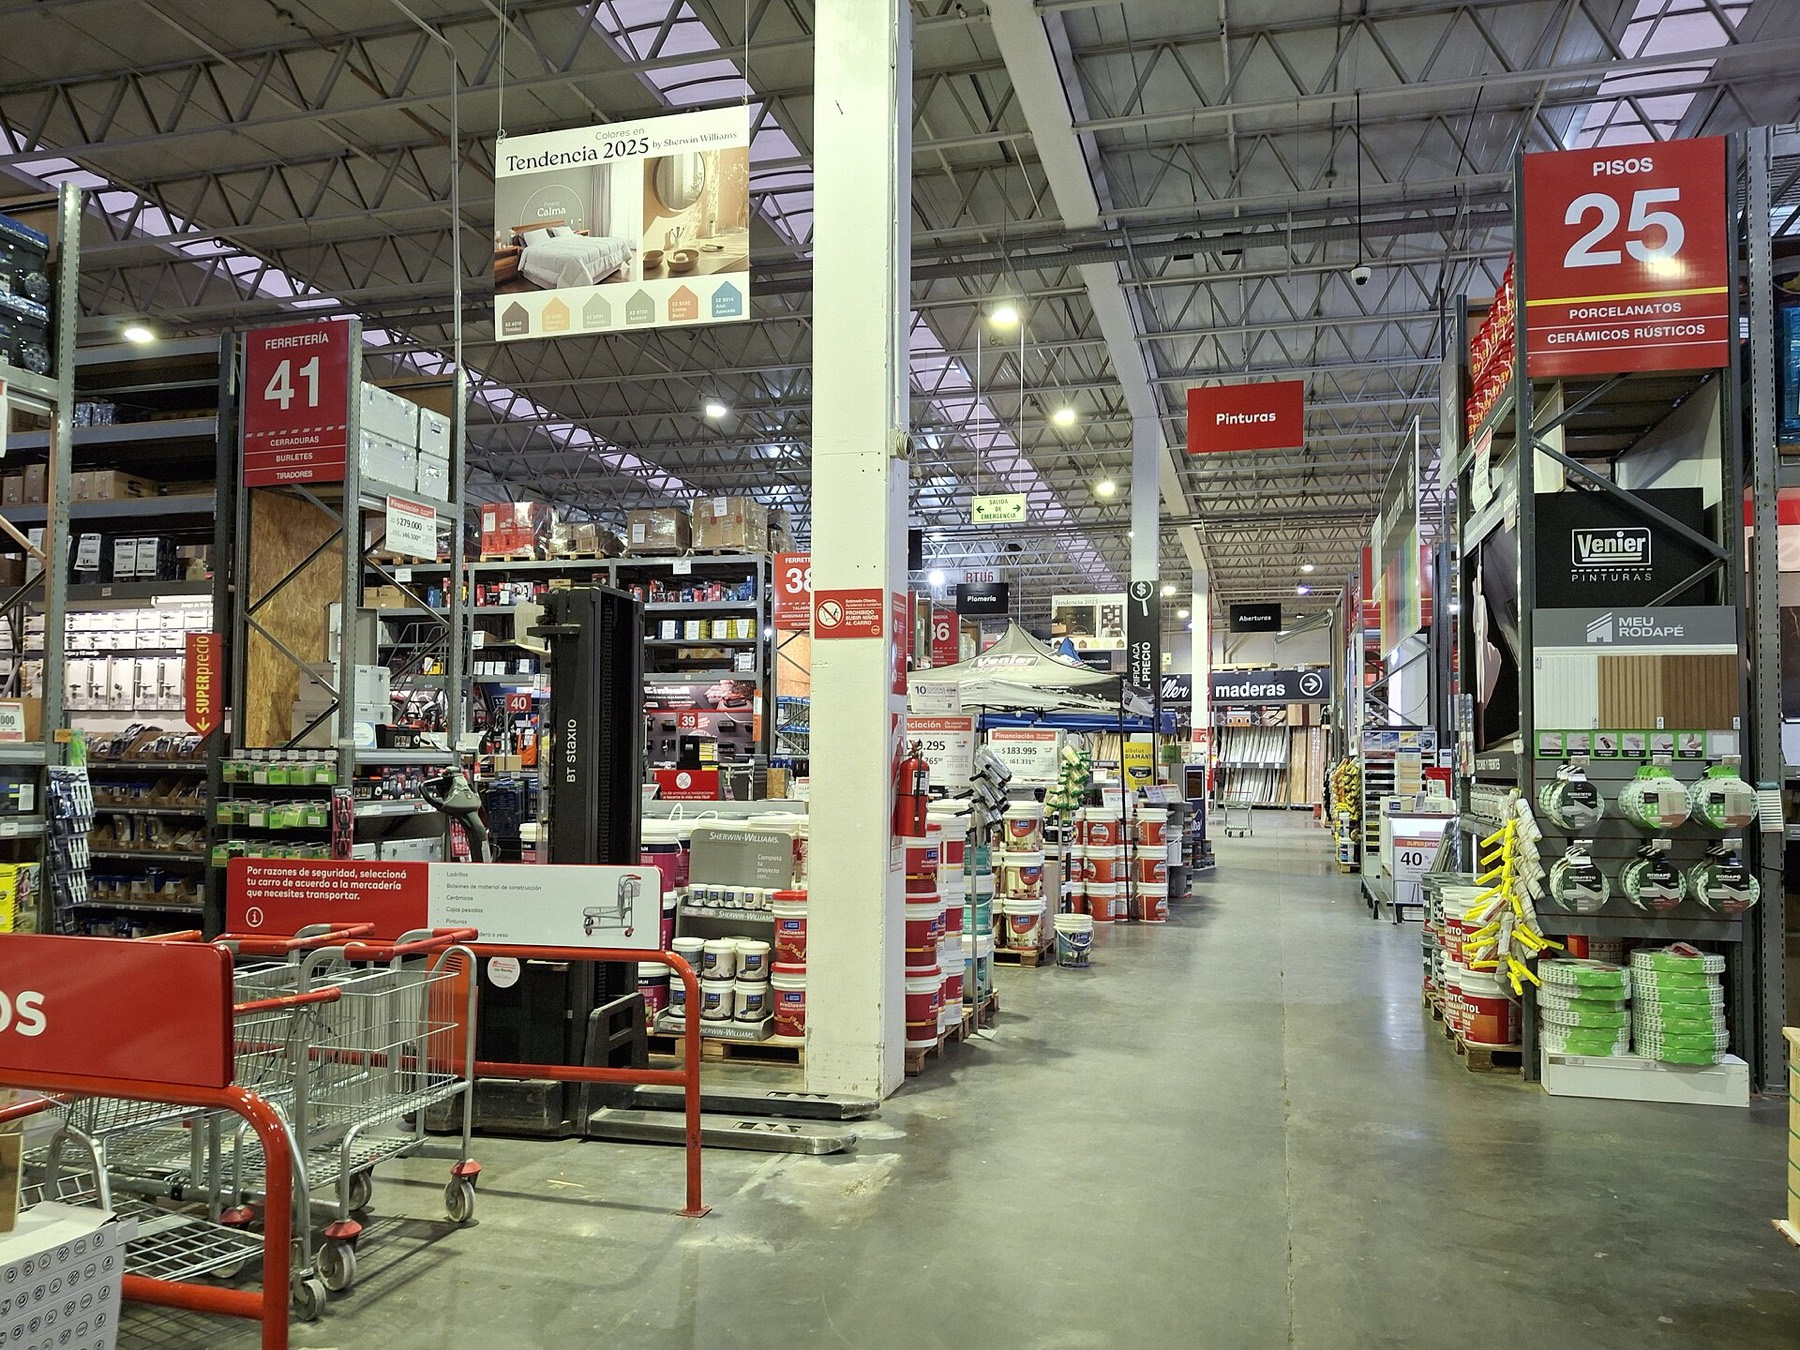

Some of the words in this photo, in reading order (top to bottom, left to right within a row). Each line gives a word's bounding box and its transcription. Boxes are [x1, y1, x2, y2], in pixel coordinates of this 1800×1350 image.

[595, 129, 631, 141] Colores
[633, 127, 645, 136] en
[652, 139, 663, 149] by
[663, 135, 699, 148] Sherwin
[700, 131, 738, 143] Williams
[506, 145, 598, 171] Tendencia
[603, 137, 650, 159] 2025
[1593, 157, 1653, 176] PISOS
[537, 206, 567, 217] Calma
[1564, 187, 1685, 268] 25
[1569, 302, 1682, 320] PORCELANATOS
[1547, 327, 1630, 345] CERÁMICOS
[1634, 323, 1706, 340] RÚSTICOS
[265, 332, 329, 350] FERRETERÍA
[264, 356, 320, 410] 41
[1216, 411, 1277, 426] Pinturas
[270, 436, 320, 447] CERRADURAS
[276, 452, 313, 463] BURLETES
[276, 470, 313, 480] TIRADORES
[981, 512, 1017, 520] EMERGENCIA
[1577, 530, 1646, 558] Venier
[966, 571, 994, 582] RTU6
[1571, 572, 1653, 583] PINTURAS
[1239, 614, 1272, 622] Aberturas
[1619, 616, 1654, 627] MEU
[1619, 624, 1684, 638] RODAPÉ
[1142, 641, 1151, 682] PRECIO
[915, 685, 926, 695] 10
[1215, 681, 1286, 699] maderas
[511, 697, 527, 709] 40
[682, 716, 696, 726] 39
[1002, 747, 1037, 755] $183.995
[566, 766, 576, 783] BT
[1400, 852, 1422, 866] 40
[247, 866, 262, 875] Por
[263, 868, 297, 876] razones
[299, 867, 310, 876] de
[311, 868, 358, 879] seguridad,
[360, 869, 407, 879] seleccioná
[247, 877, 256, 886] tu
[258, 879, 281, 887] carro
[283, 878, 293, 887] de
[295, 879, 330, 888] acuerdo
[340, 879, 349, 888] la
[350, 880, 401, 890] mercadería
[246, 890, 263, 898] que
[264, 889, 304, 898] necesites
[306, 890, 360, 901] transportar.
[446, 906, 461, 914] Cajas
[0, 989, 47, 1038] S
